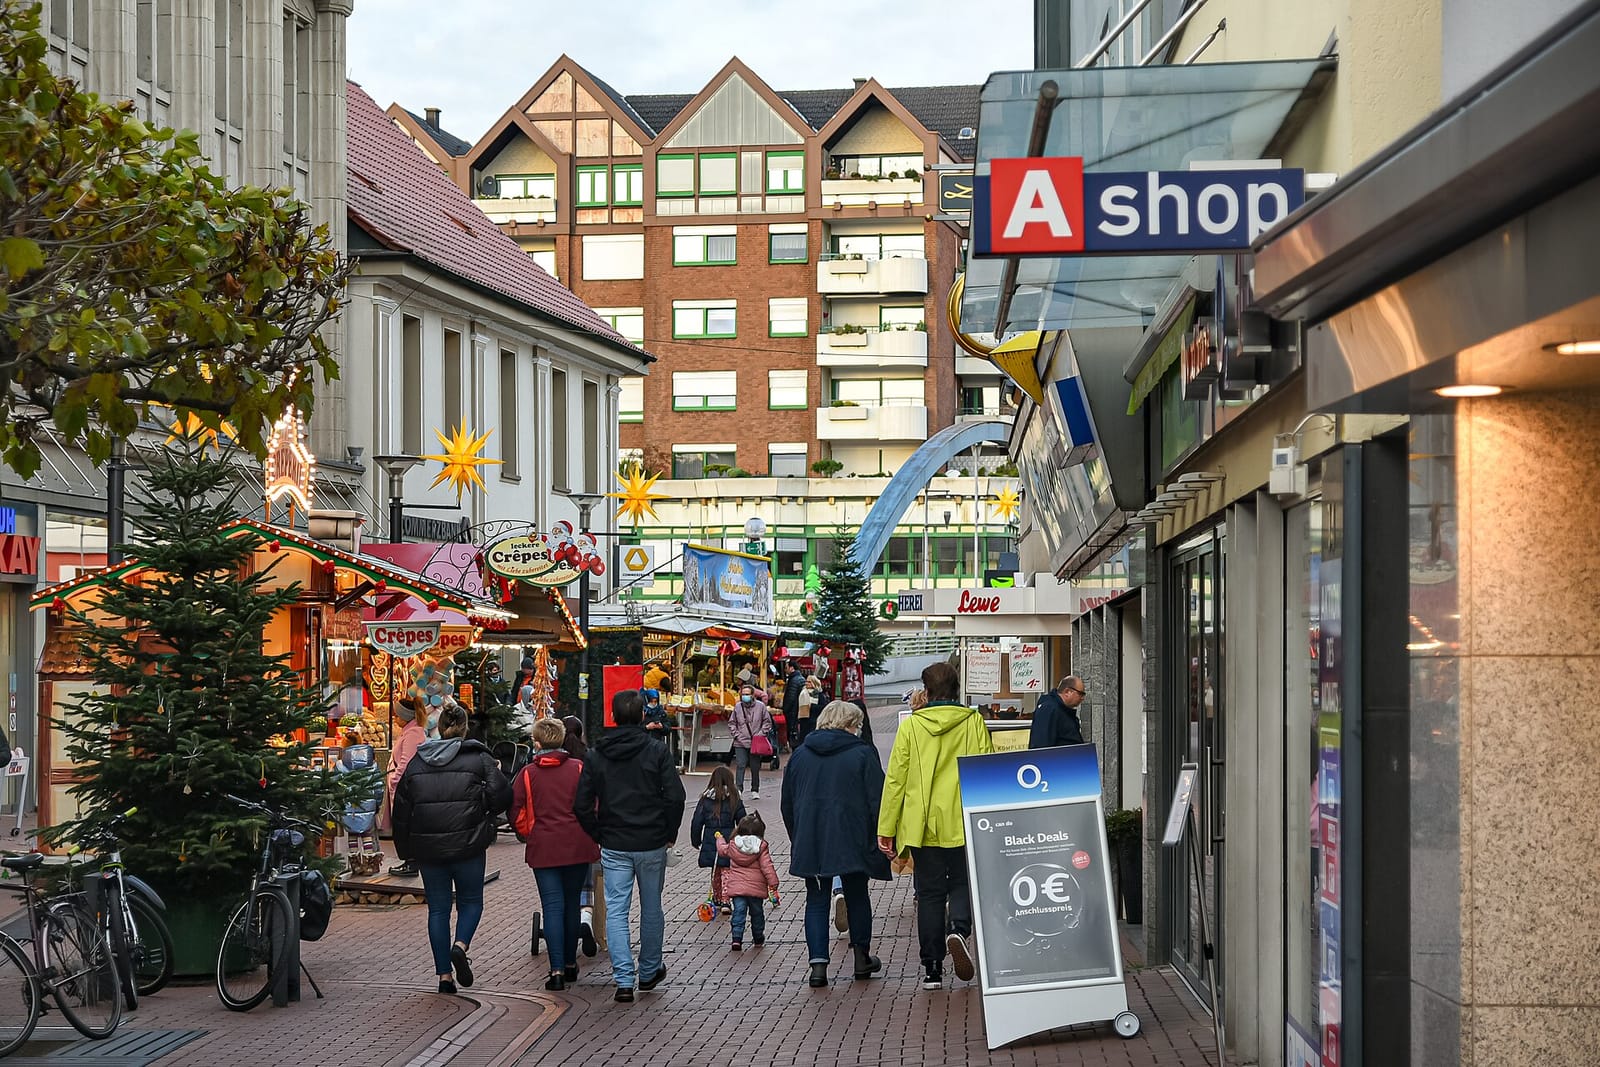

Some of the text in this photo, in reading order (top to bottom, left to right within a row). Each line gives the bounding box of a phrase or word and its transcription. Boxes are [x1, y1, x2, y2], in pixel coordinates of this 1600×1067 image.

[1002, 169, 1289, 246] A shop
[402, 515, 462, 541] OMMERZBANK
[492, 550, 548, 563] Crêpes
[898, 595, 923, 611] HEREI
[957, 590, 1000, 613] Lewe
[374, 627, 434, 646] Crêpes
[1004, 831, 1069, 846] Black Deals
[1015, 904, 1073, 917] Anschlusspreis
